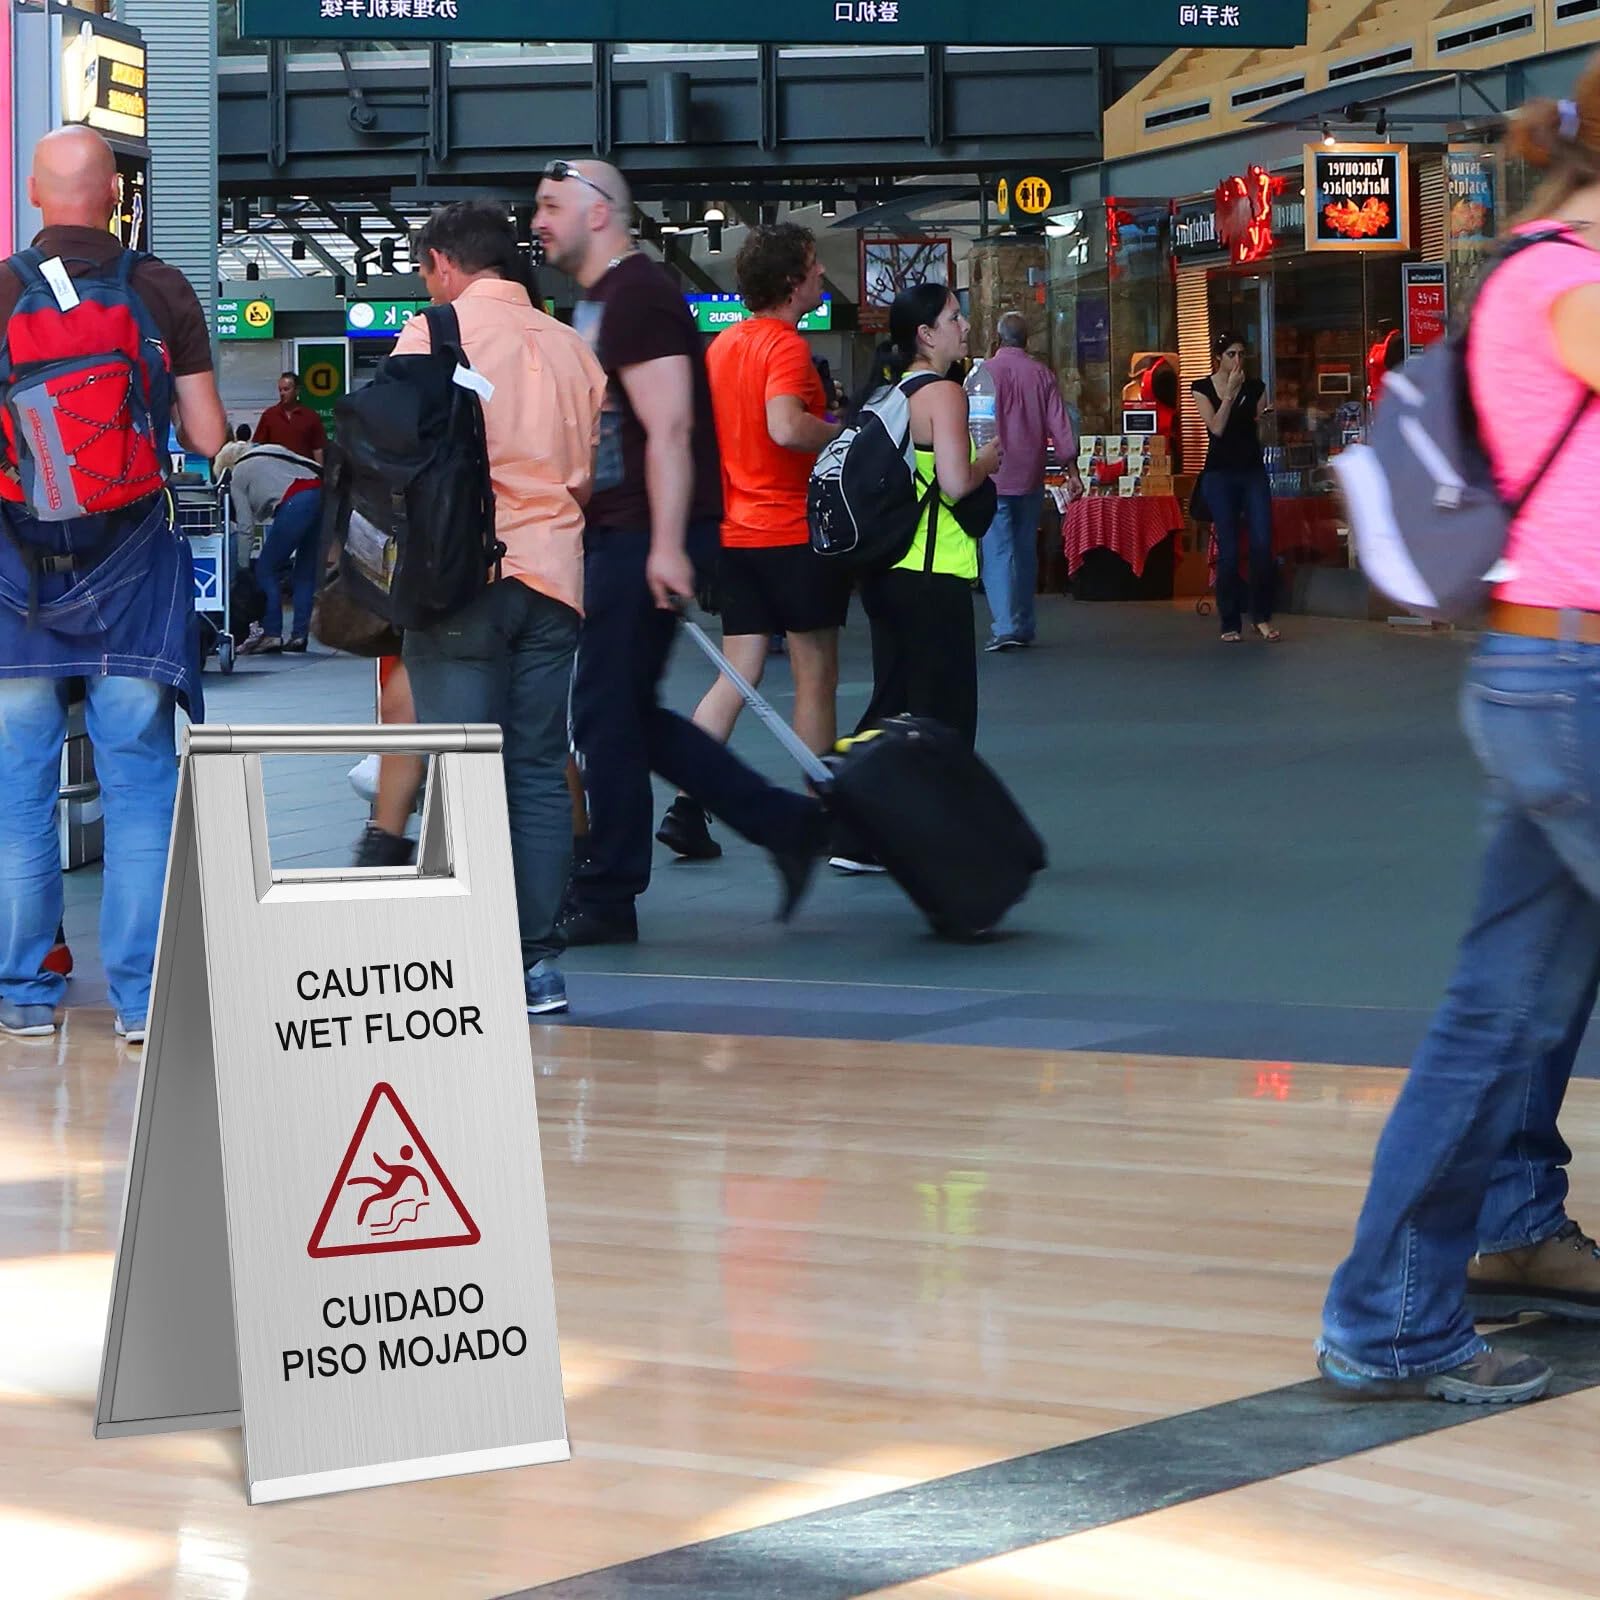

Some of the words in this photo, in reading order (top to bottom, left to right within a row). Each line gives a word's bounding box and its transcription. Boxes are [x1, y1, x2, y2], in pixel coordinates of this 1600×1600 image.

[297, 959, 454, 1001] CAUTION
[275, 1016, 353, 1051] WET
[365, 1005, 484, 1044] FLOOR
[322, 1283, 484, 1329] CUIDADO
[282, 1343, 367, 1382] PISO
[378, 1325, 527, 1371] MOJADO
